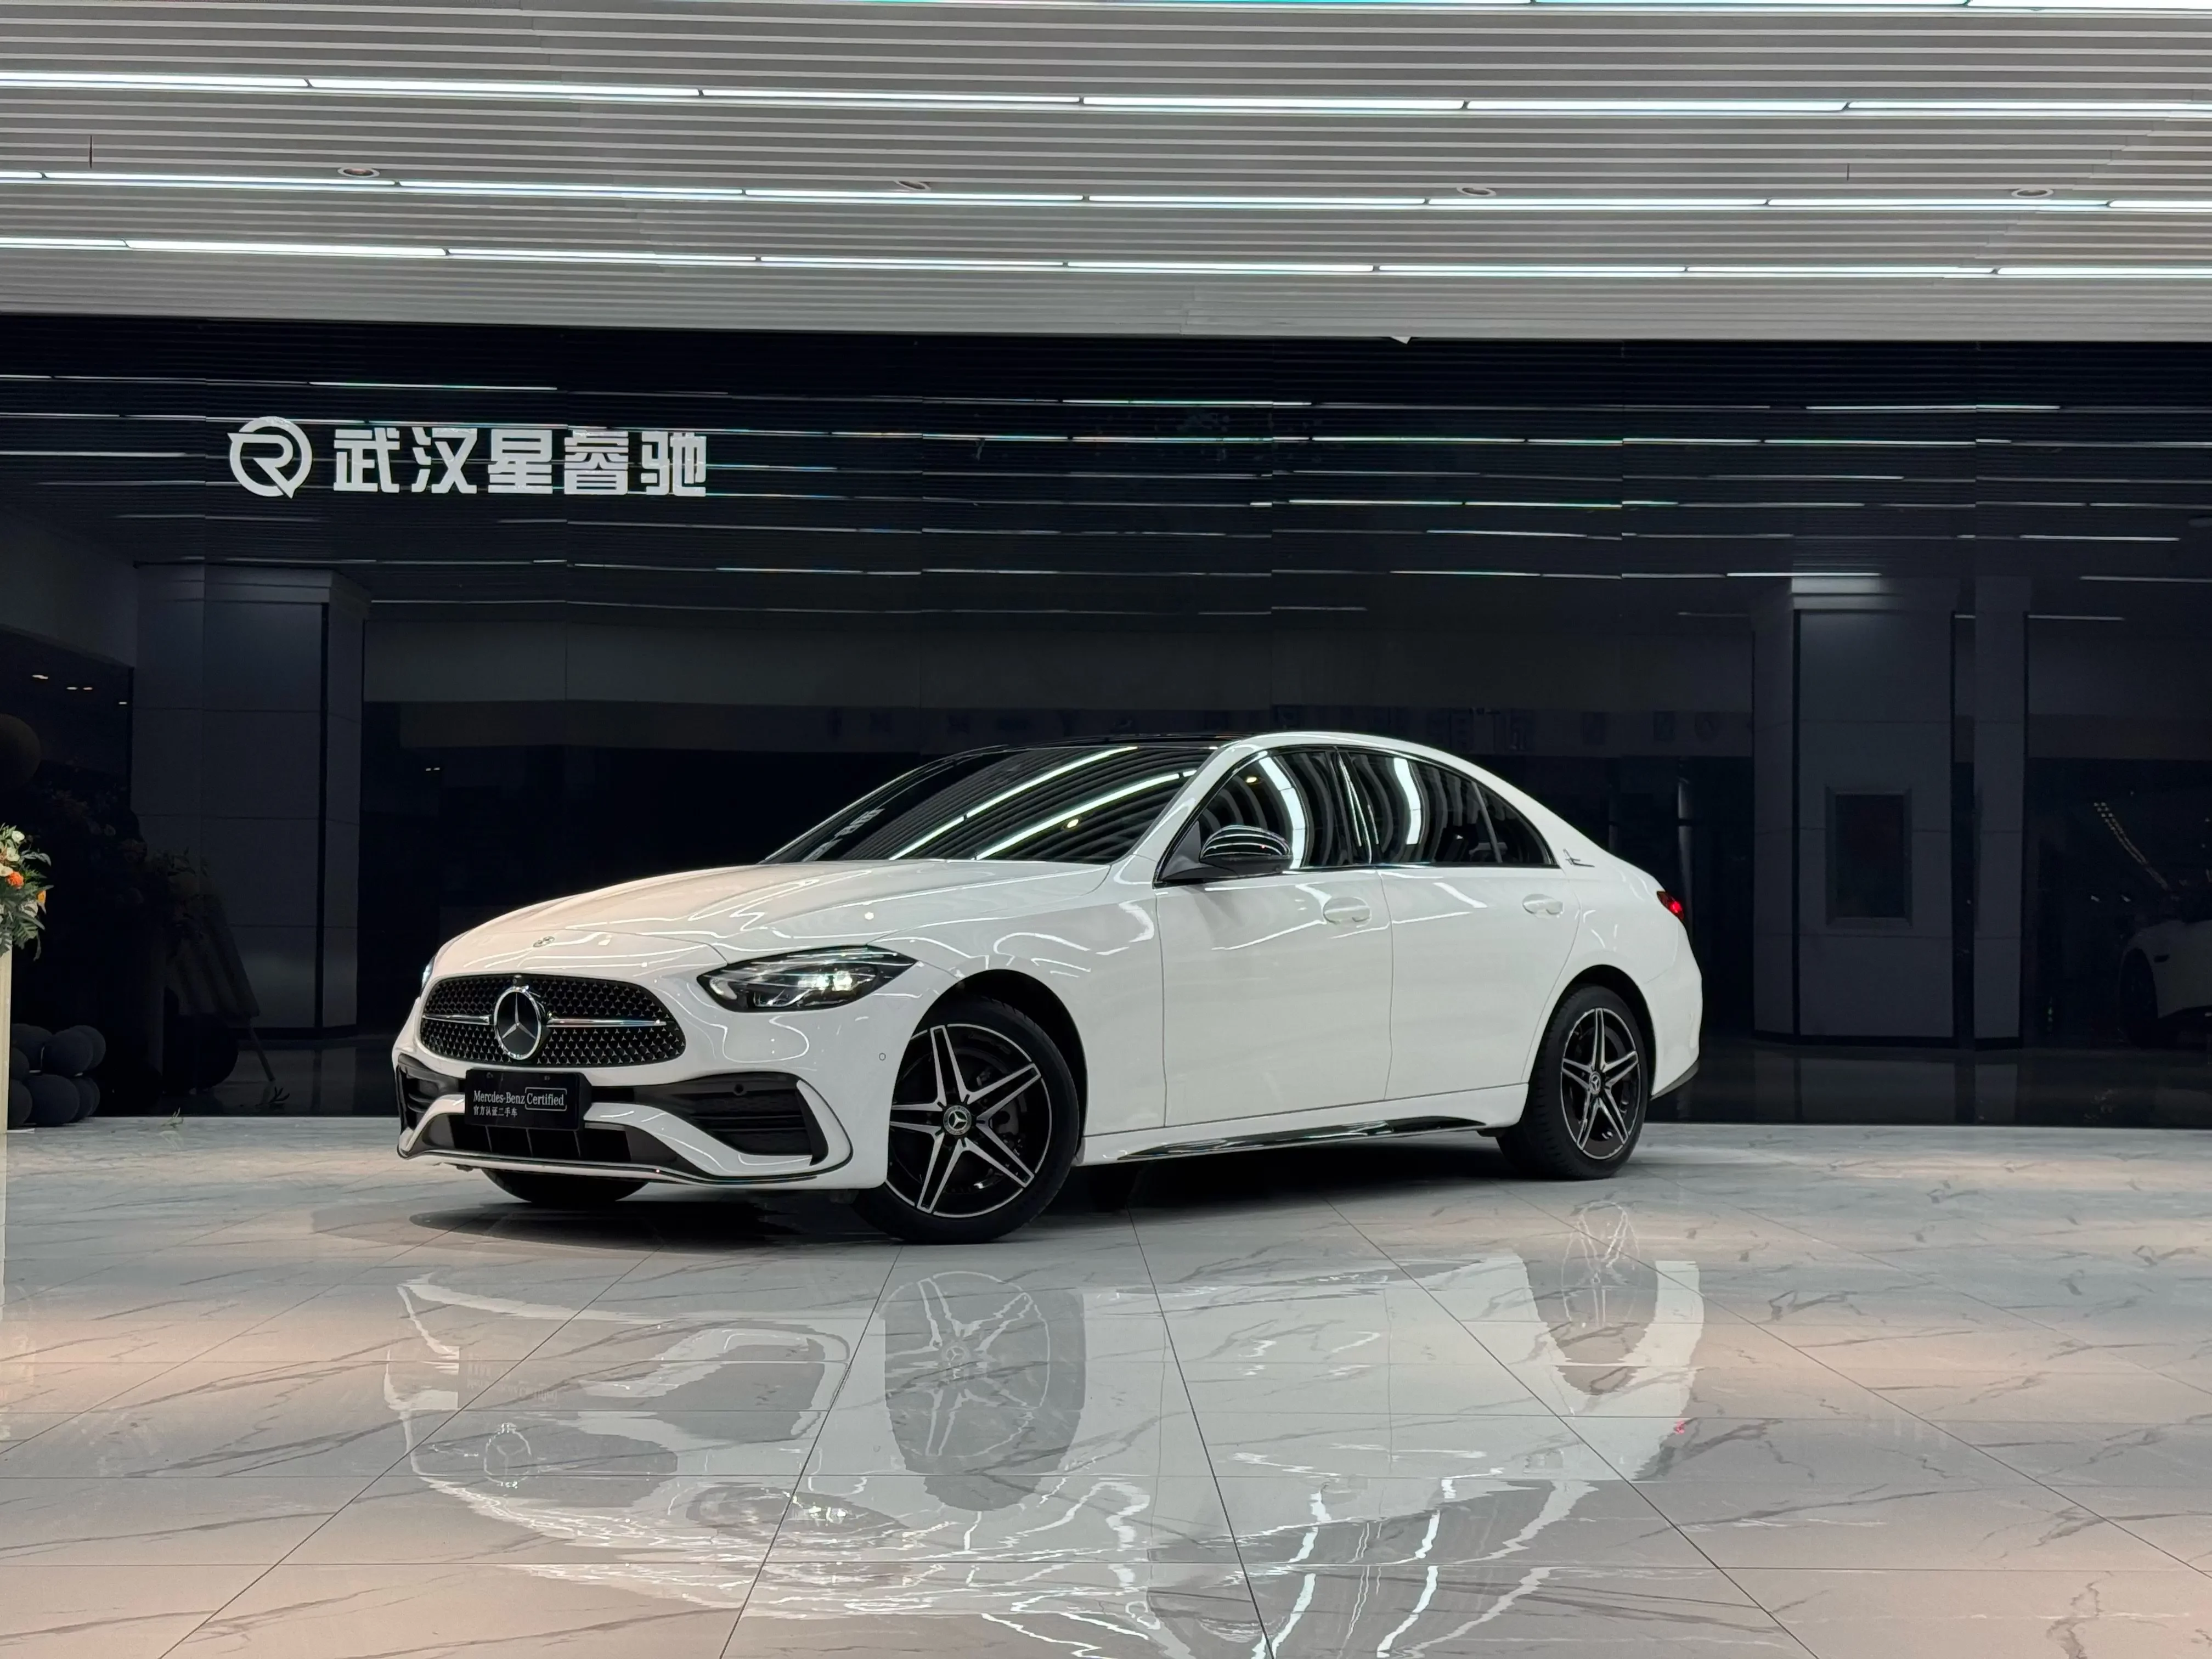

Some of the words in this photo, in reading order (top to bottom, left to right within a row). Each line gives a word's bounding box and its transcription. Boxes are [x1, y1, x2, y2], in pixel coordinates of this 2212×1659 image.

[333, 427, 707, 497] 武汉星睿驰
[527, 1092, 565, 1106] Certified
[473, 1105, 518, 1118] 官方认证二手车
